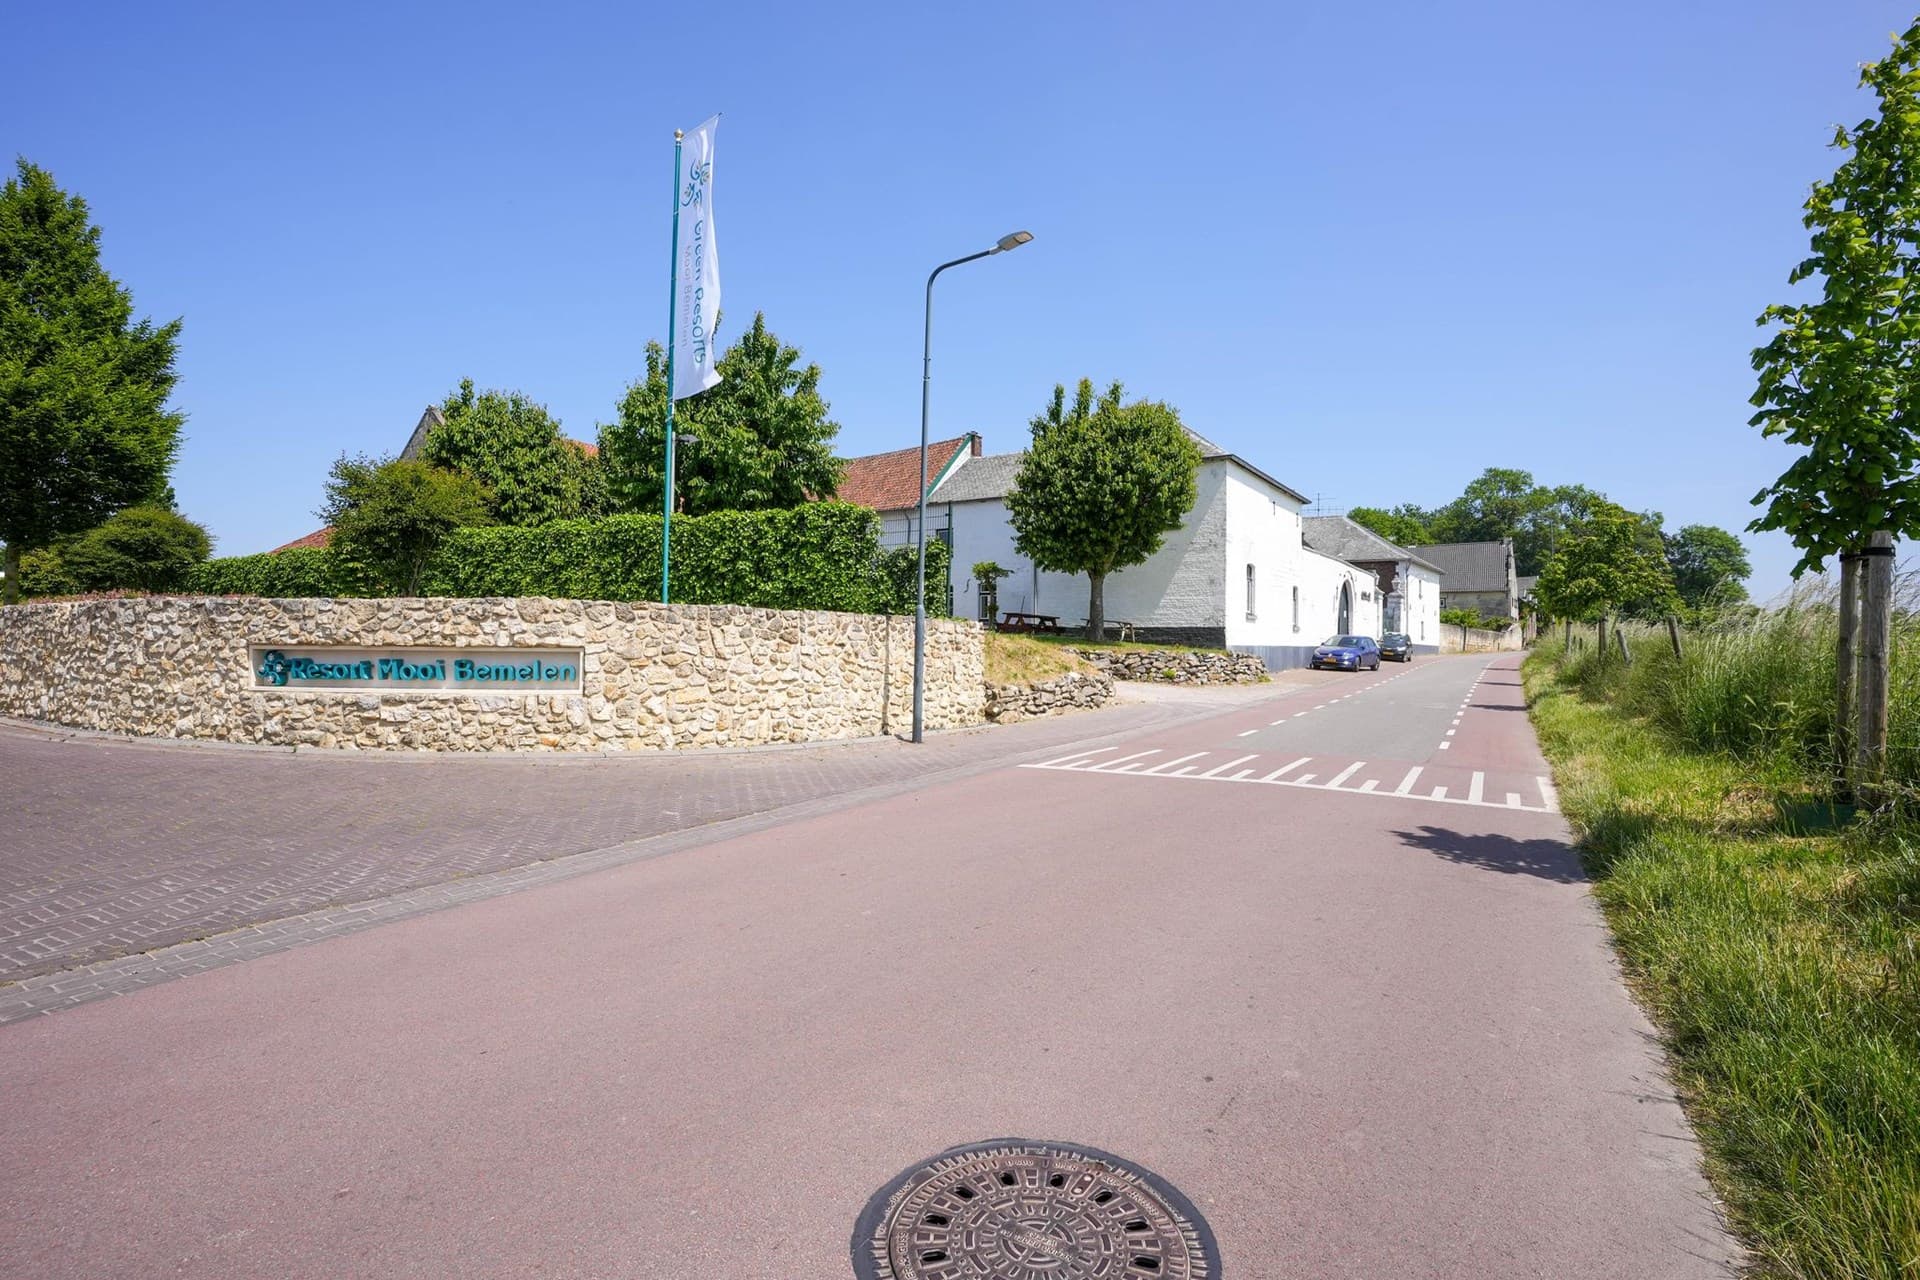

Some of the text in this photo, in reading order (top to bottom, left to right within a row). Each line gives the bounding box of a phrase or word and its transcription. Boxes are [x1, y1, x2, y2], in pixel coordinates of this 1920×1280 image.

[692, 287, 706, 364] Resorts
[290, 657, 577, 682] Resort Mooi Bemelen
